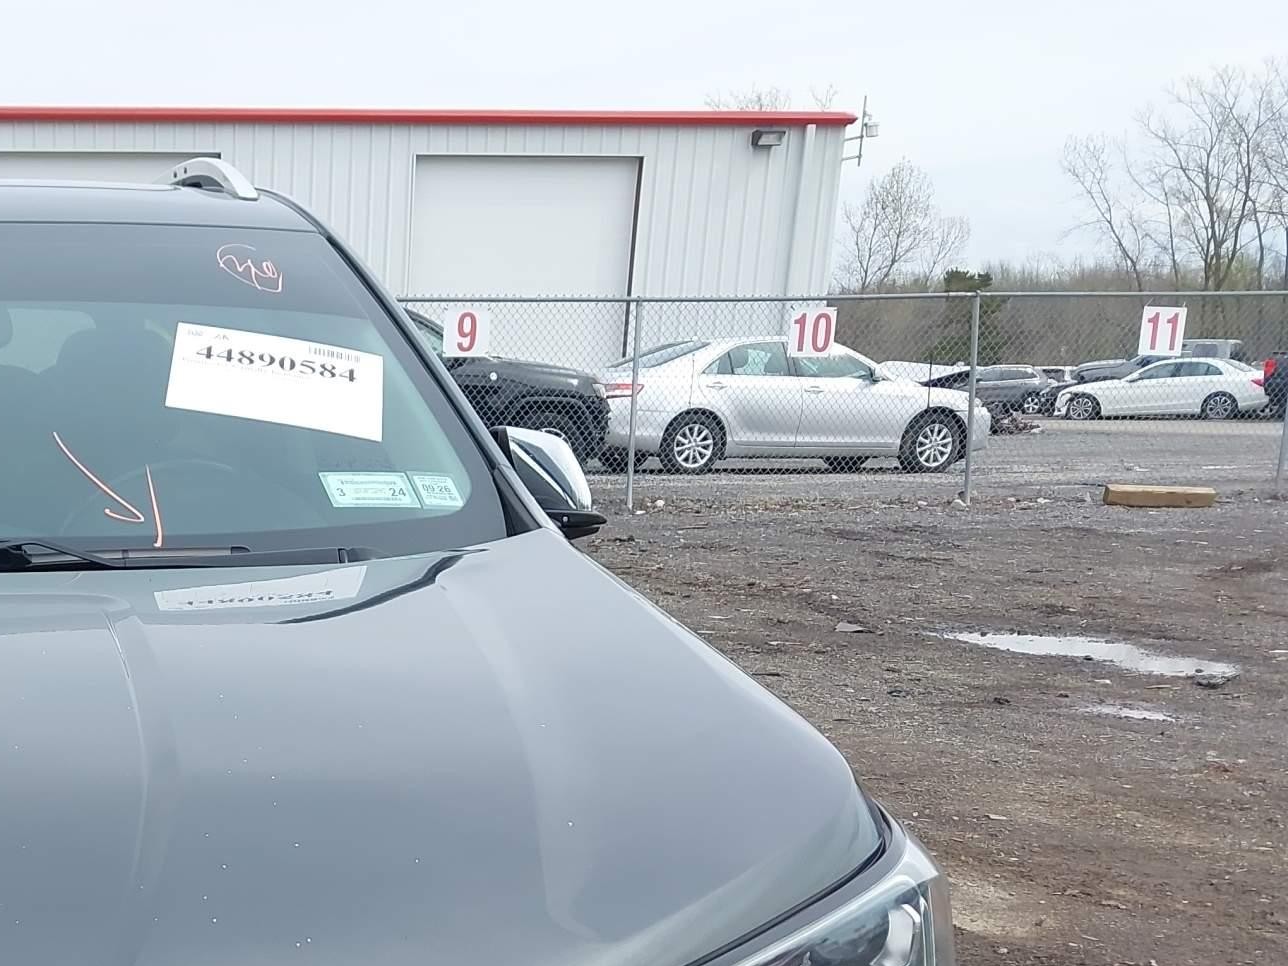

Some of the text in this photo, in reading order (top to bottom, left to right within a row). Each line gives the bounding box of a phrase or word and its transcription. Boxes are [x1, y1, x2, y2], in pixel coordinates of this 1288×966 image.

[457, 312, 478, 352] 9
[794, 313, 833, 353] 10
[1148, 312, 1180, 351] 11
[196, 345, 357, 383] 44890584
[388, 488, 407, 497] 24
